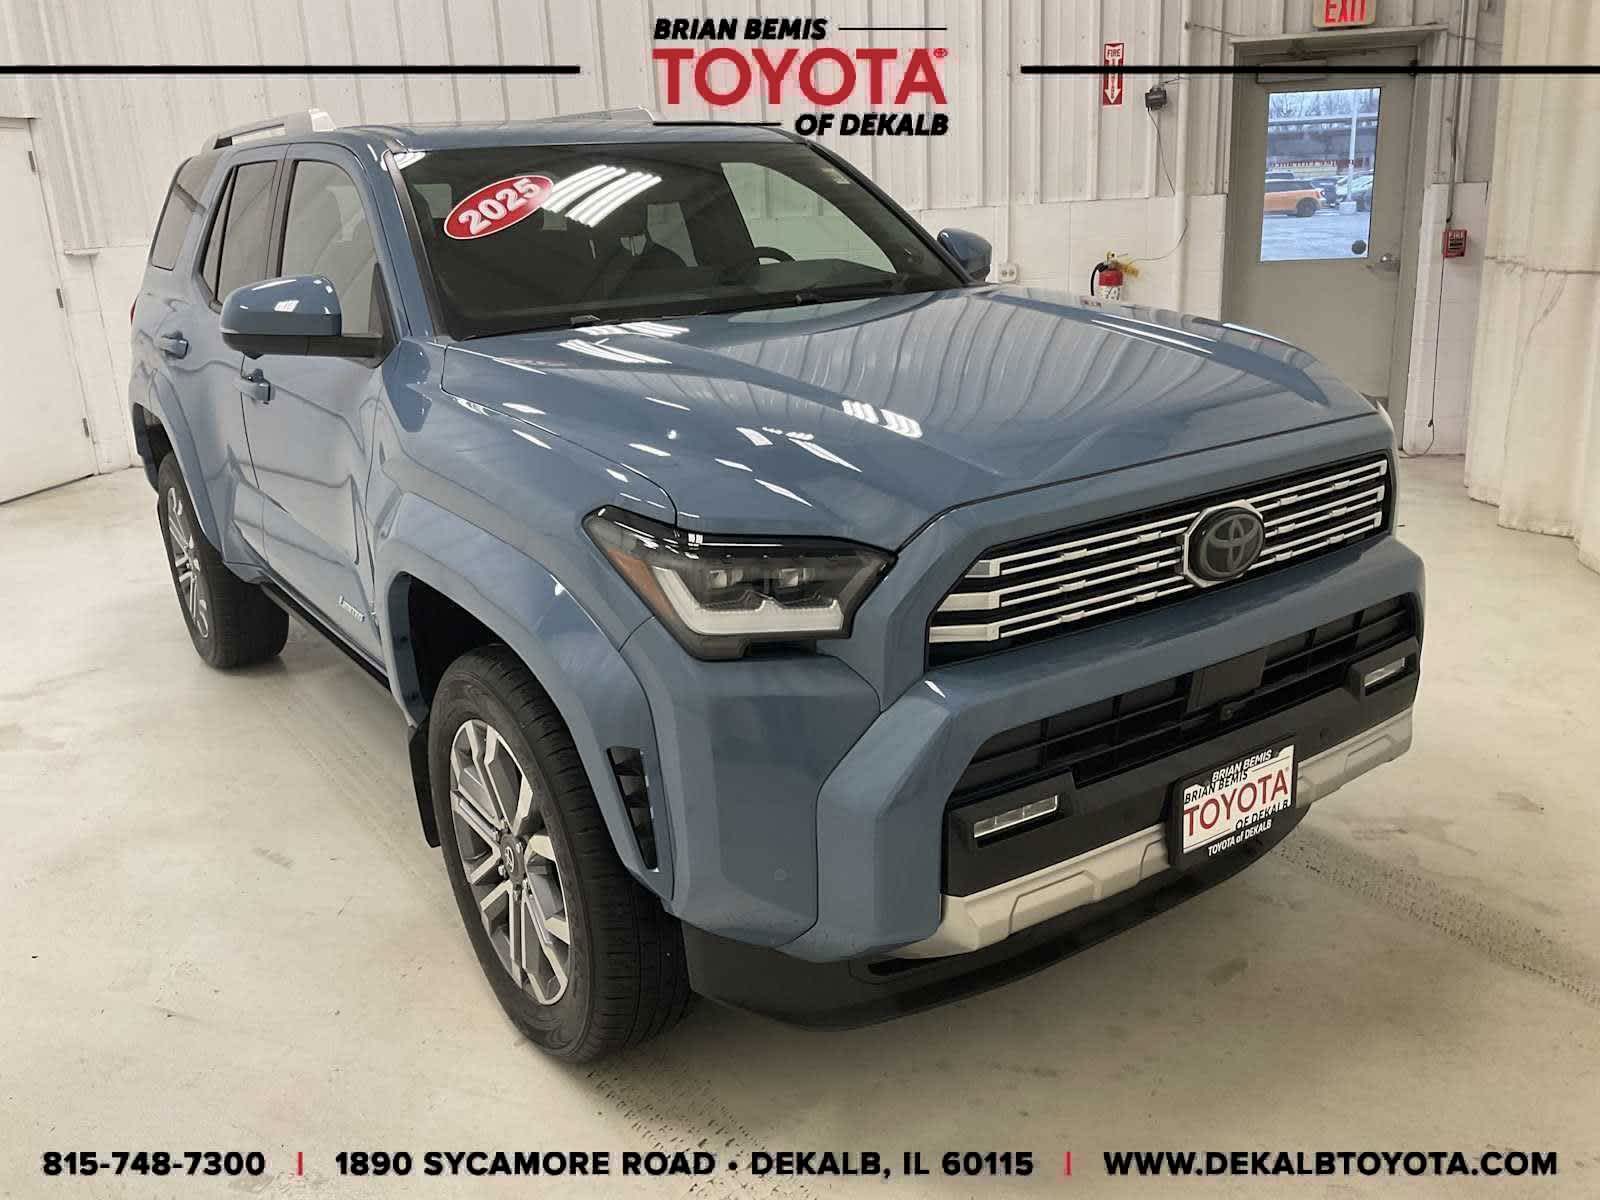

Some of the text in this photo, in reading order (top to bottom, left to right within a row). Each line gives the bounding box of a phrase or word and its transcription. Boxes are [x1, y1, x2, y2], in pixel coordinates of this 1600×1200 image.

[1107, 48, 1121, 58] FIRE
[458, 177, 541, 235] 2025
[1212, 749, 1272, 782] BRIAN BEMIS
[1184, 782, 1216, 804] BRIAN
[1184, 769, 1288, 836] TOYOTA
[1207, 838, 1236, 857] TOYOTA
[1244, 819, 1272, 839] DEKALB
